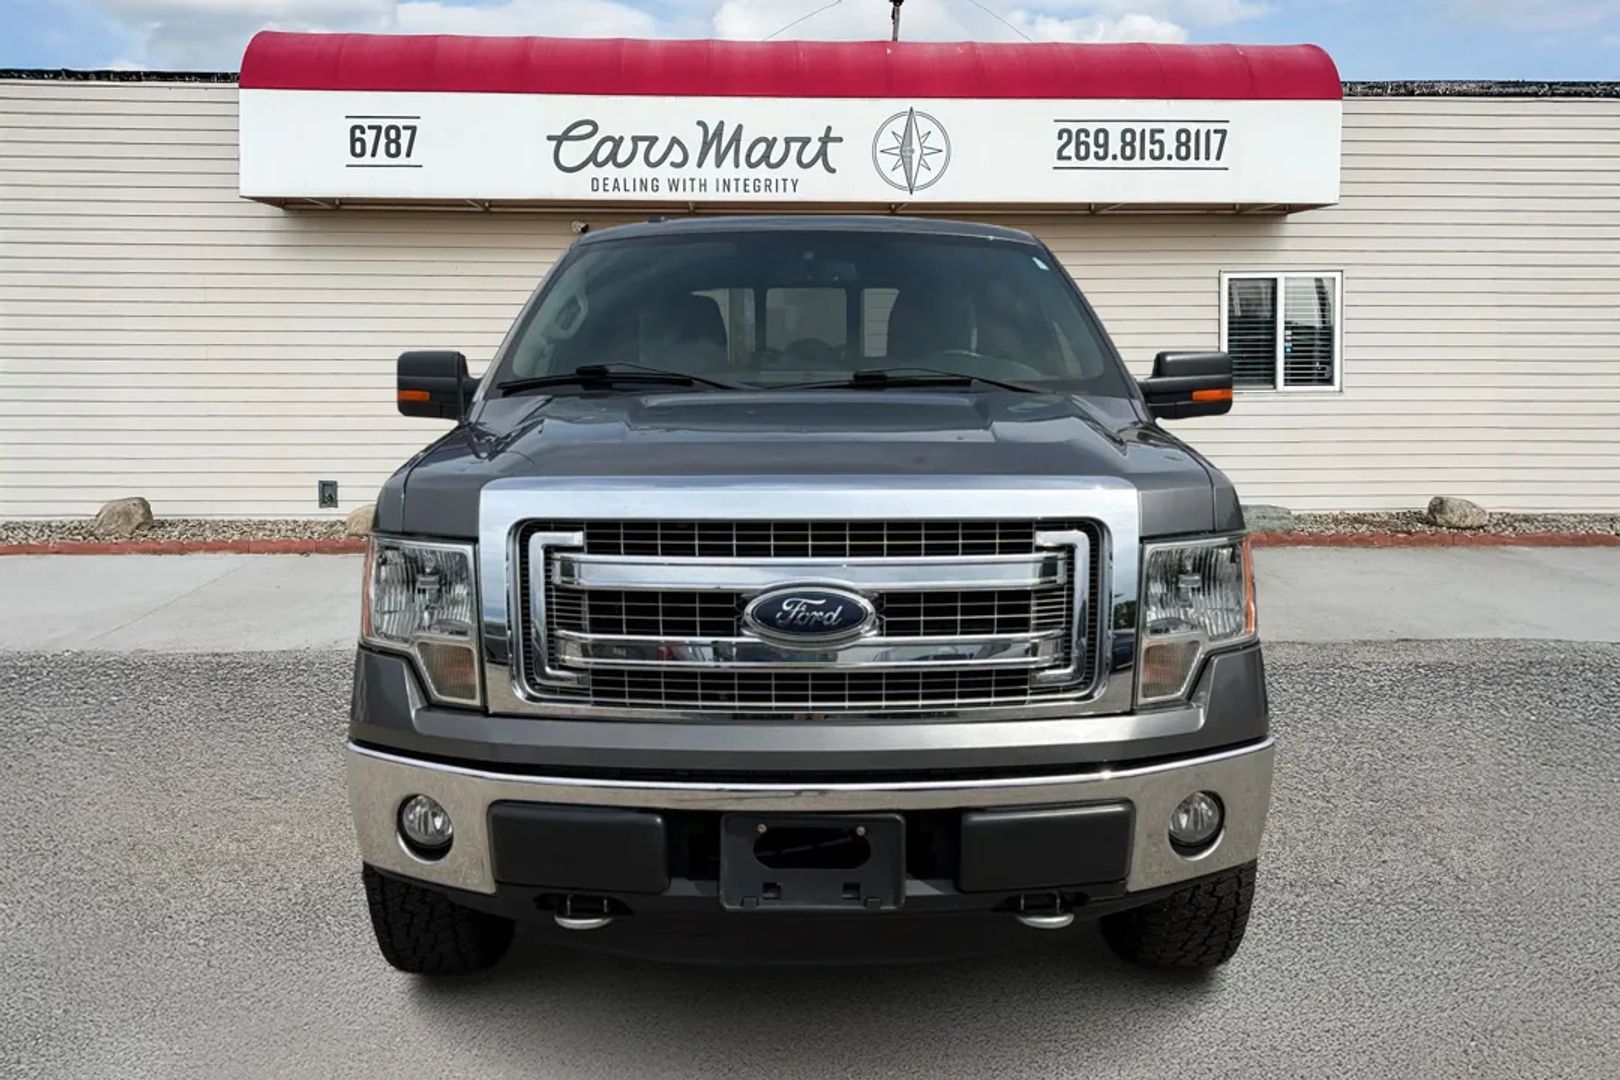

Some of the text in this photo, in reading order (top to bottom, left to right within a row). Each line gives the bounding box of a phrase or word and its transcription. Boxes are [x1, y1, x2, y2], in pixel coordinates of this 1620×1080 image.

[349, 124, 418, 159] 6787
[1056, 127, 1229, 162] 269.815.8117
[590, 177, 800, 193] DEALING WITH INTEGRITY
[775, 597, 844, 627] Ford
